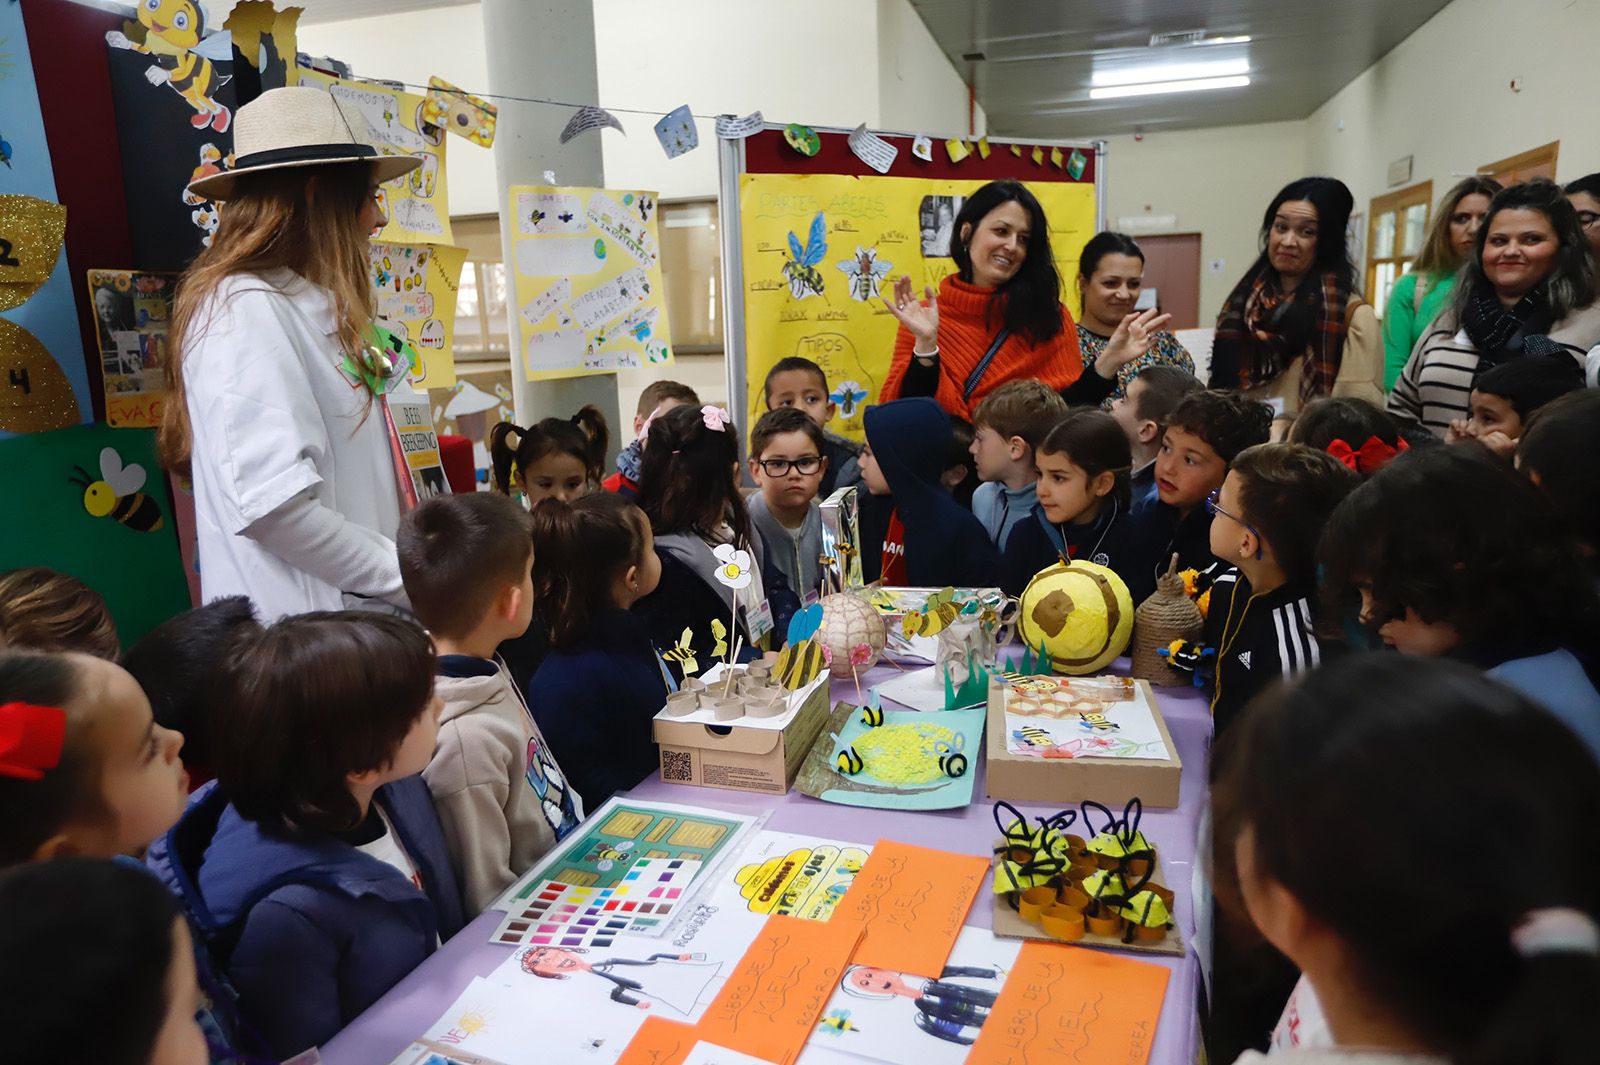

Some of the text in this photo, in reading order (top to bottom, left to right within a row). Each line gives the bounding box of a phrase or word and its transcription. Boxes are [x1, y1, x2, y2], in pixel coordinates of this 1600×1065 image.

[804, 338, 844, 353] TIPOS
[816, 354, 831, 366] DE
[9, 367, 32, 396] 4
[886, 887, 921, 927] MIEL
[719, 937, 780, 1021] LIBRO DE LA
[753, 966, 797, 1017] MIEL
[1003, 1007, 1033, 1049] LIBRO
[1022, 983, 1043, 1001] DE
[1036, 962, 1055, 979] LA
[1047, 1001, 1088, 1057] MIEL
